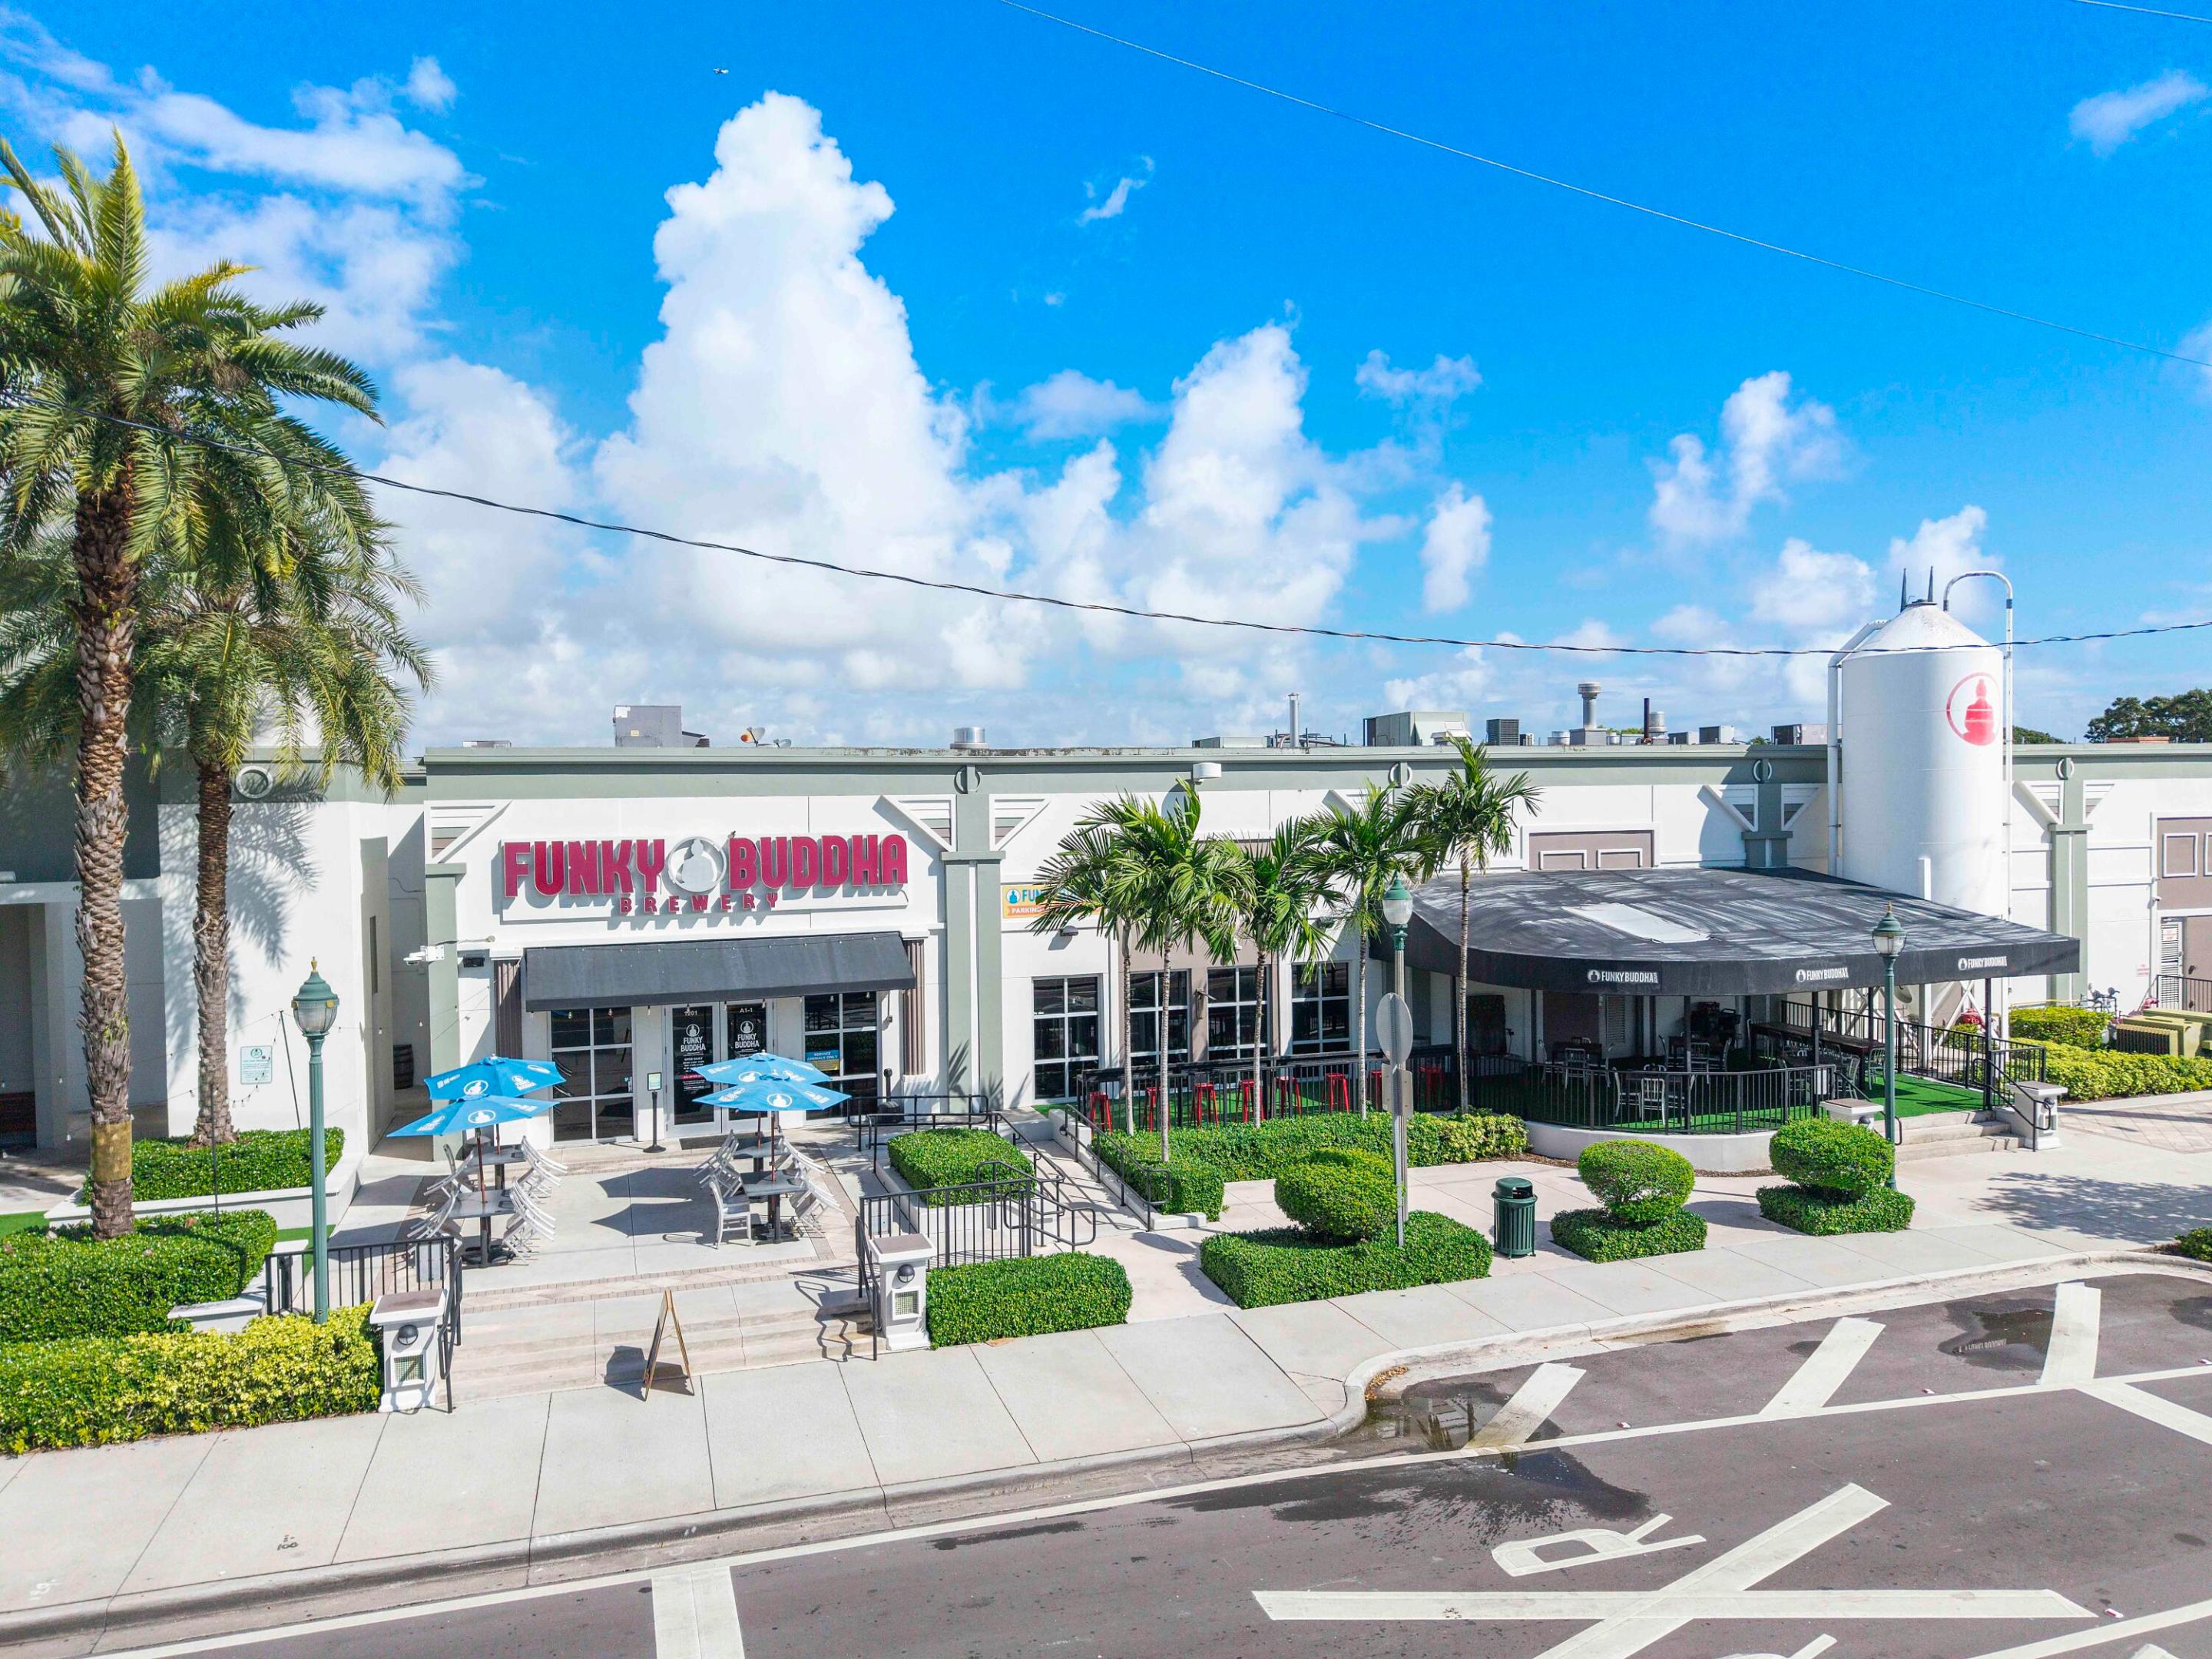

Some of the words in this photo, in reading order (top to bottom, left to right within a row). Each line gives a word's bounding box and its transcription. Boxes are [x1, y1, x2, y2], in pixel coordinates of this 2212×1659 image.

[504, 839, 665, 897] FUNKY
[729, 834, 908, 891] BUDDHA
[619, 892, 778, 914] BREWERY
[1601, 971, 1624, 982] FUNKY
[1624, 972, 1654, 983] BUDDHA
[1806, 969, 1824, 981] FUNKY
[1824, 968, 1846, 979] BUDDHA
[684, 1036, 703, 1045] FUNKY
[734, 1040, 760, 1049] BUDDHA
[680, 1043, 706, 1052] BUDDHA
